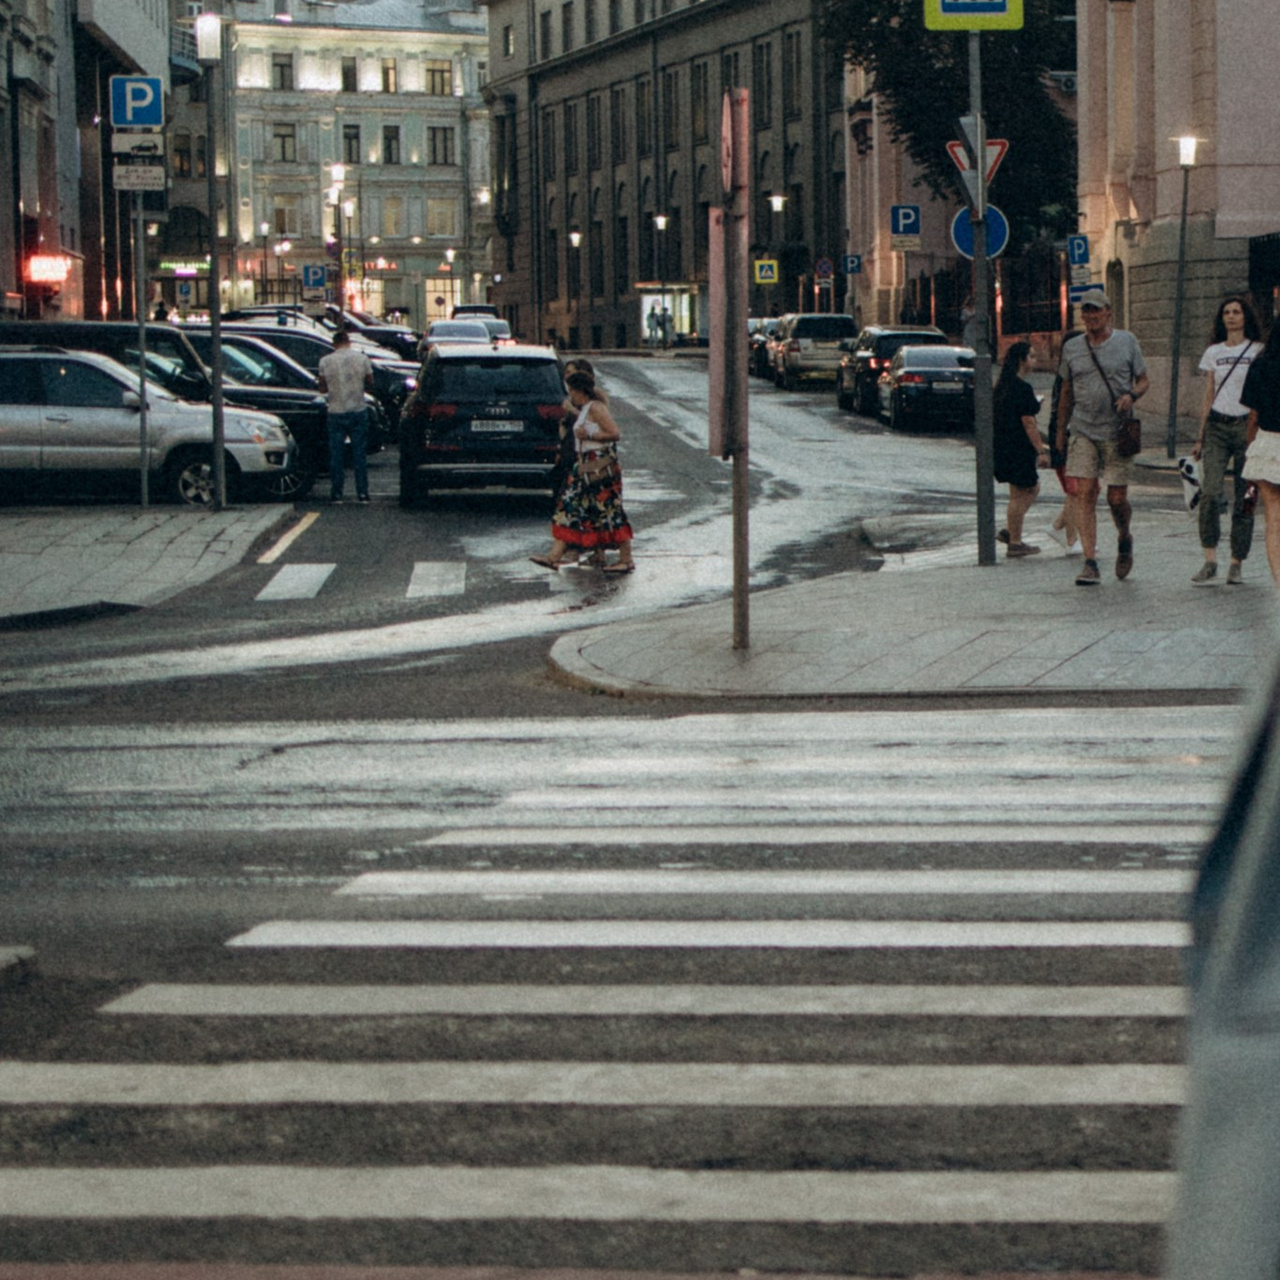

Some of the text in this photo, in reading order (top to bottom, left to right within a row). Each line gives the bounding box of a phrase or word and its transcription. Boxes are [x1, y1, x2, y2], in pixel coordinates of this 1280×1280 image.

[125, 81, 153, 120] P
[898, 208, 915, 232] P
[1074, 239, 1085, 262] P
[847, 257, 858, 271] P
[309, 267, 321, 286] P
